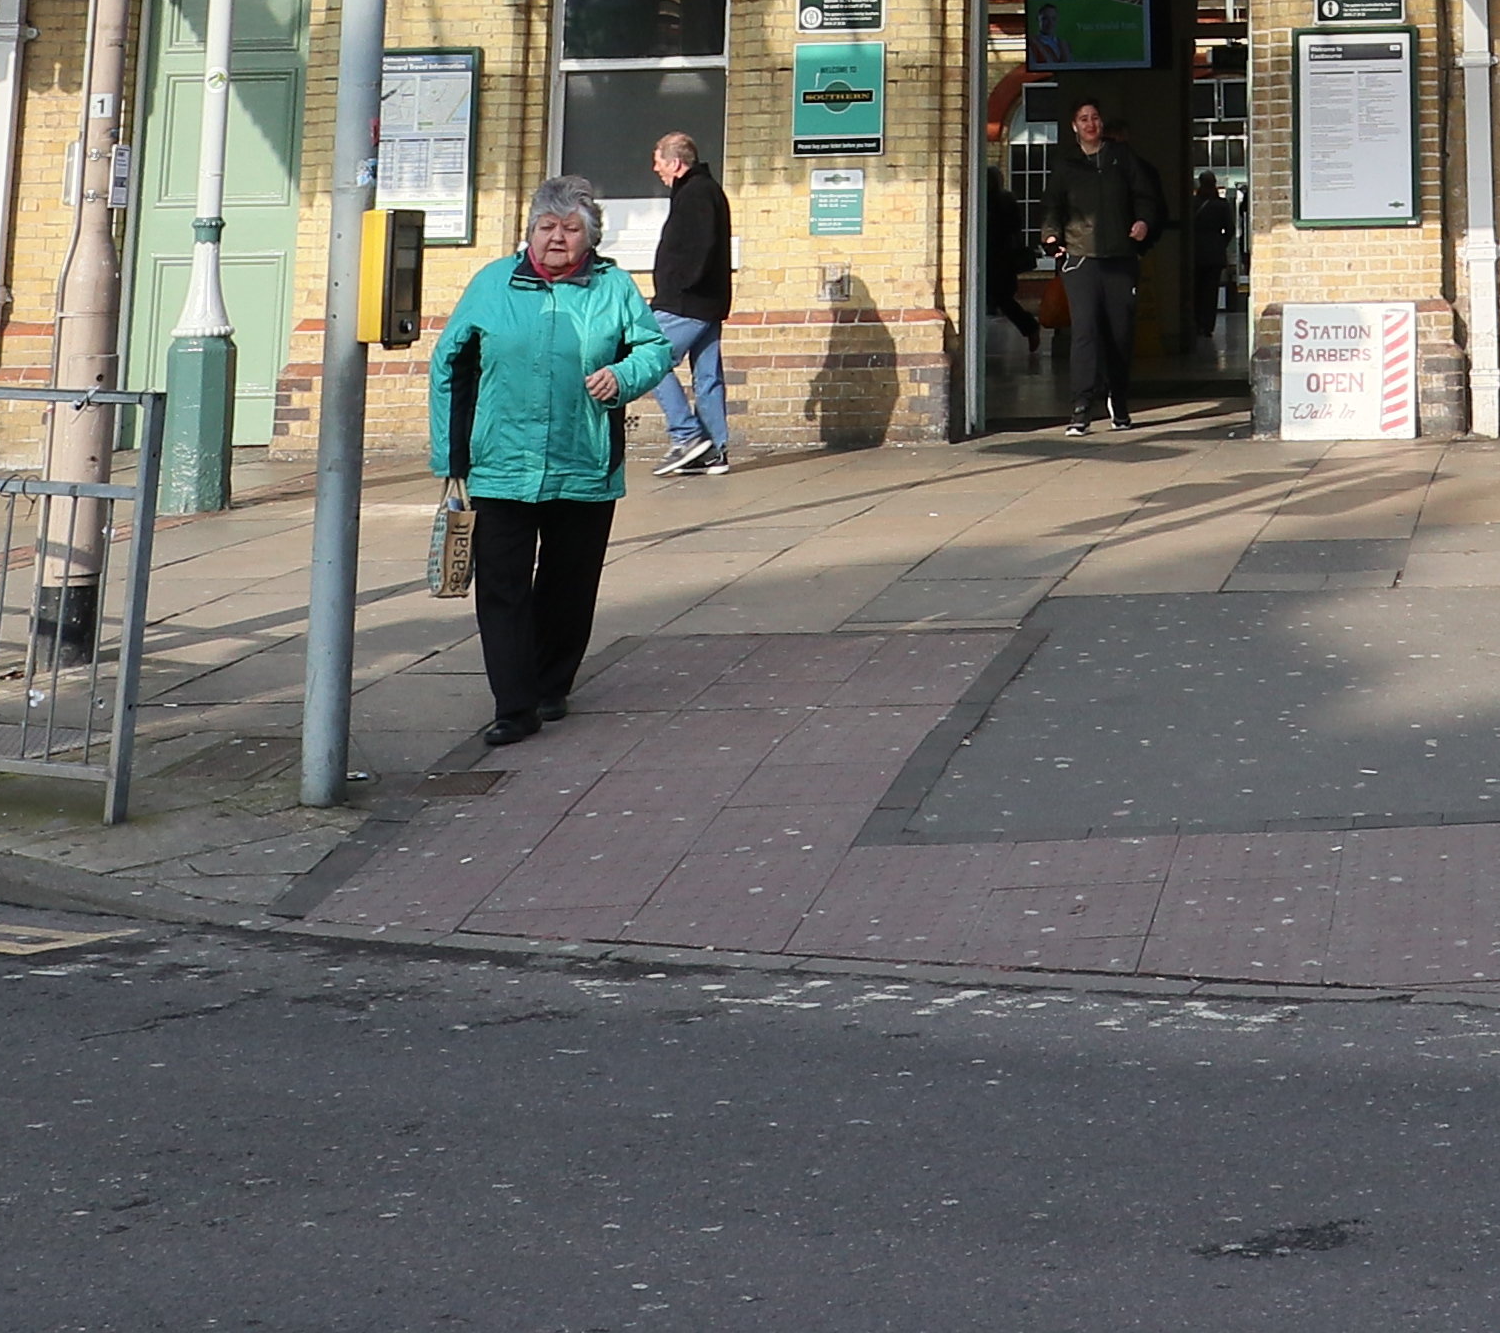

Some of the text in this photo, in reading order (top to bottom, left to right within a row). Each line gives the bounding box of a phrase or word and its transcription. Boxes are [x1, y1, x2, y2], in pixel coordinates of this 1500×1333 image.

[97, 98, 105, 114] 1
[805, 93, 870, 101] SOUTHERN
[1293, 318, 1371, 340] STATION
[1291, 344, 1372, 362] BARBERS
[1306, 372, 1364, 393] OPEN
[449, 522, 470, 593] seasalt
